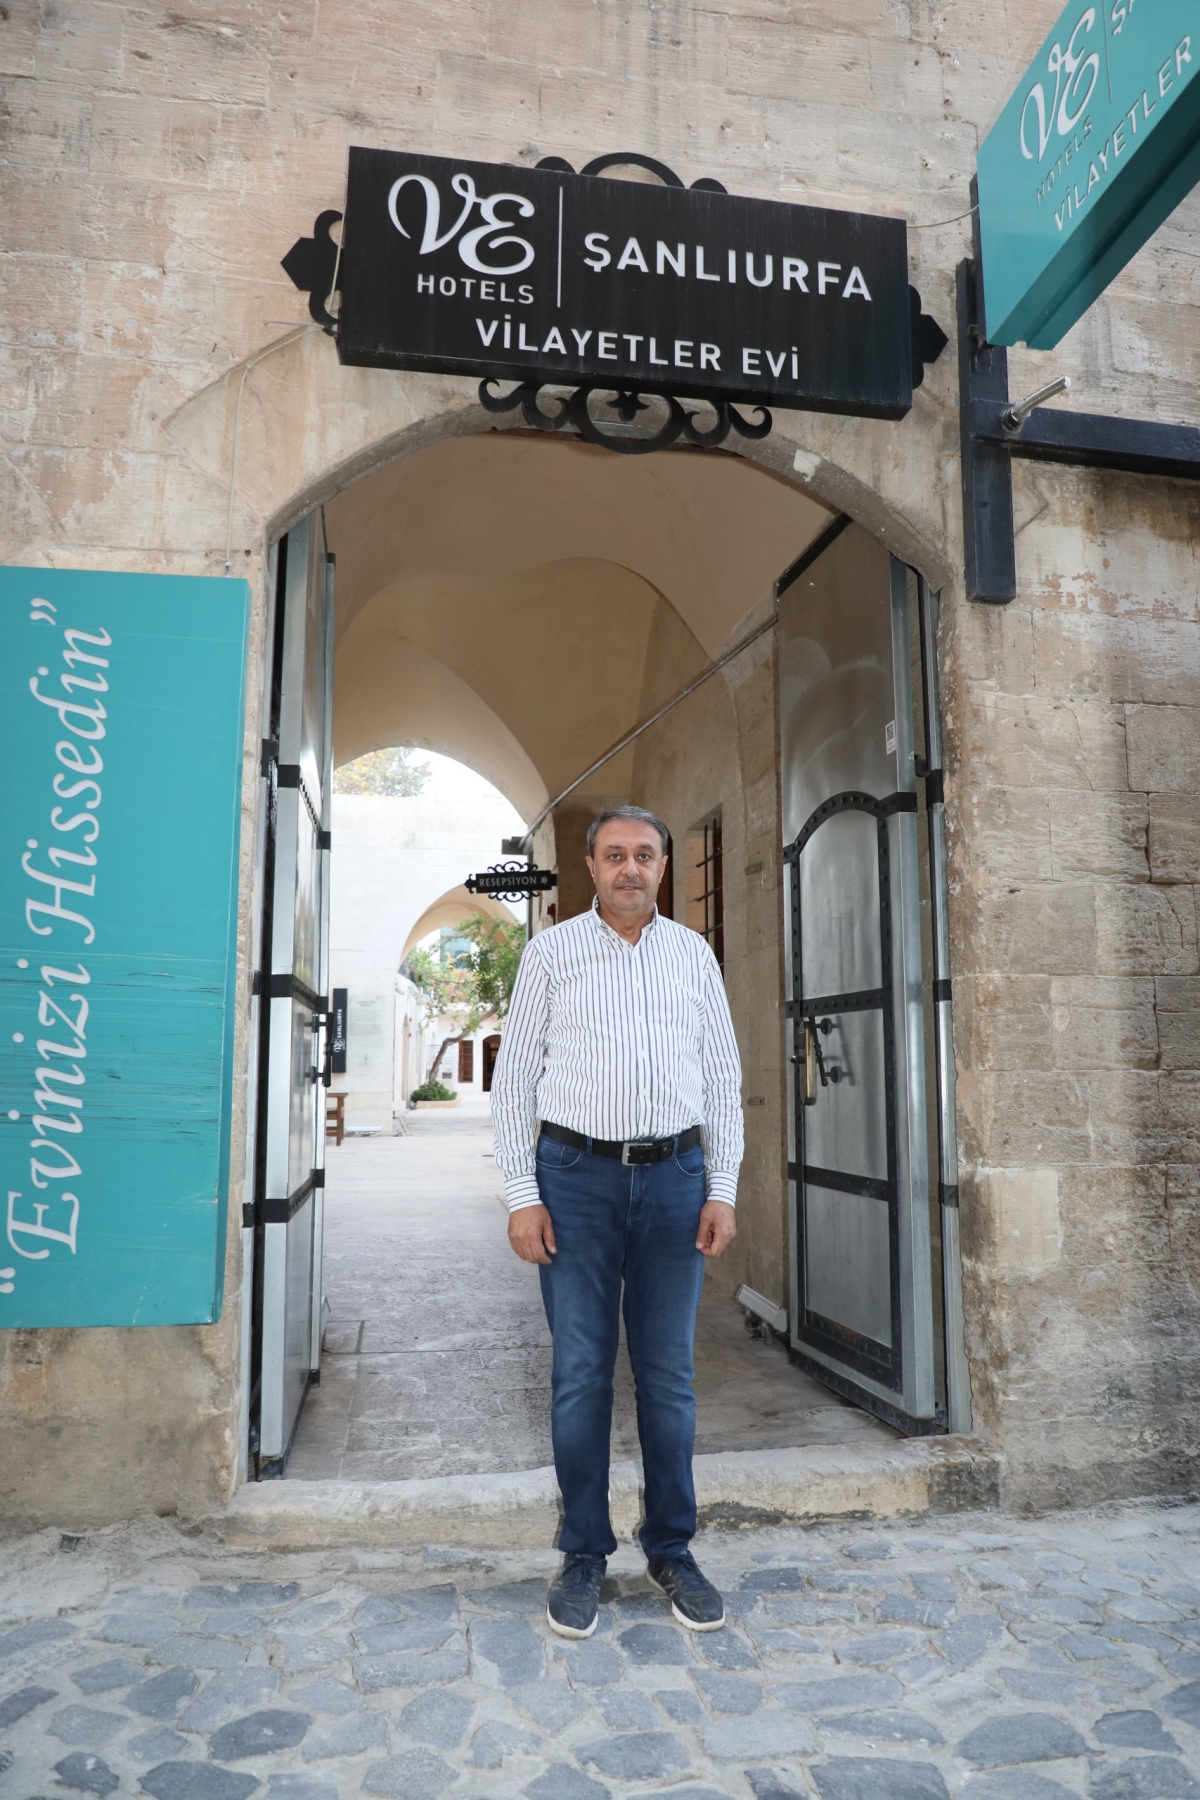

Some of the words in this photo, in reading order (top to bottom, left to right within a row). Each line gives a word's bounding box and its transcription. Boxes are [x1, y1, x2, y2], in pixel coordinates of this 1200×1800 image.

[1020, 6, 1099, 163] VE
[1037, 115, 1092, 205] HOTELS
[1053, 34, 1192, 232] VİLAYETLER
[387, 173, 535, 275] VE
[583, 232, 872, 301] ŞANLIURFA
[417, 273, 534, 305] HOTELS
[475, 314, 722, 371] VİLAYETLER
[742, 345, 799, 380] EVİ
[21, 597, 112, 945] Hissedin”
[479, 875, 537, 887] RESEPSİYON
